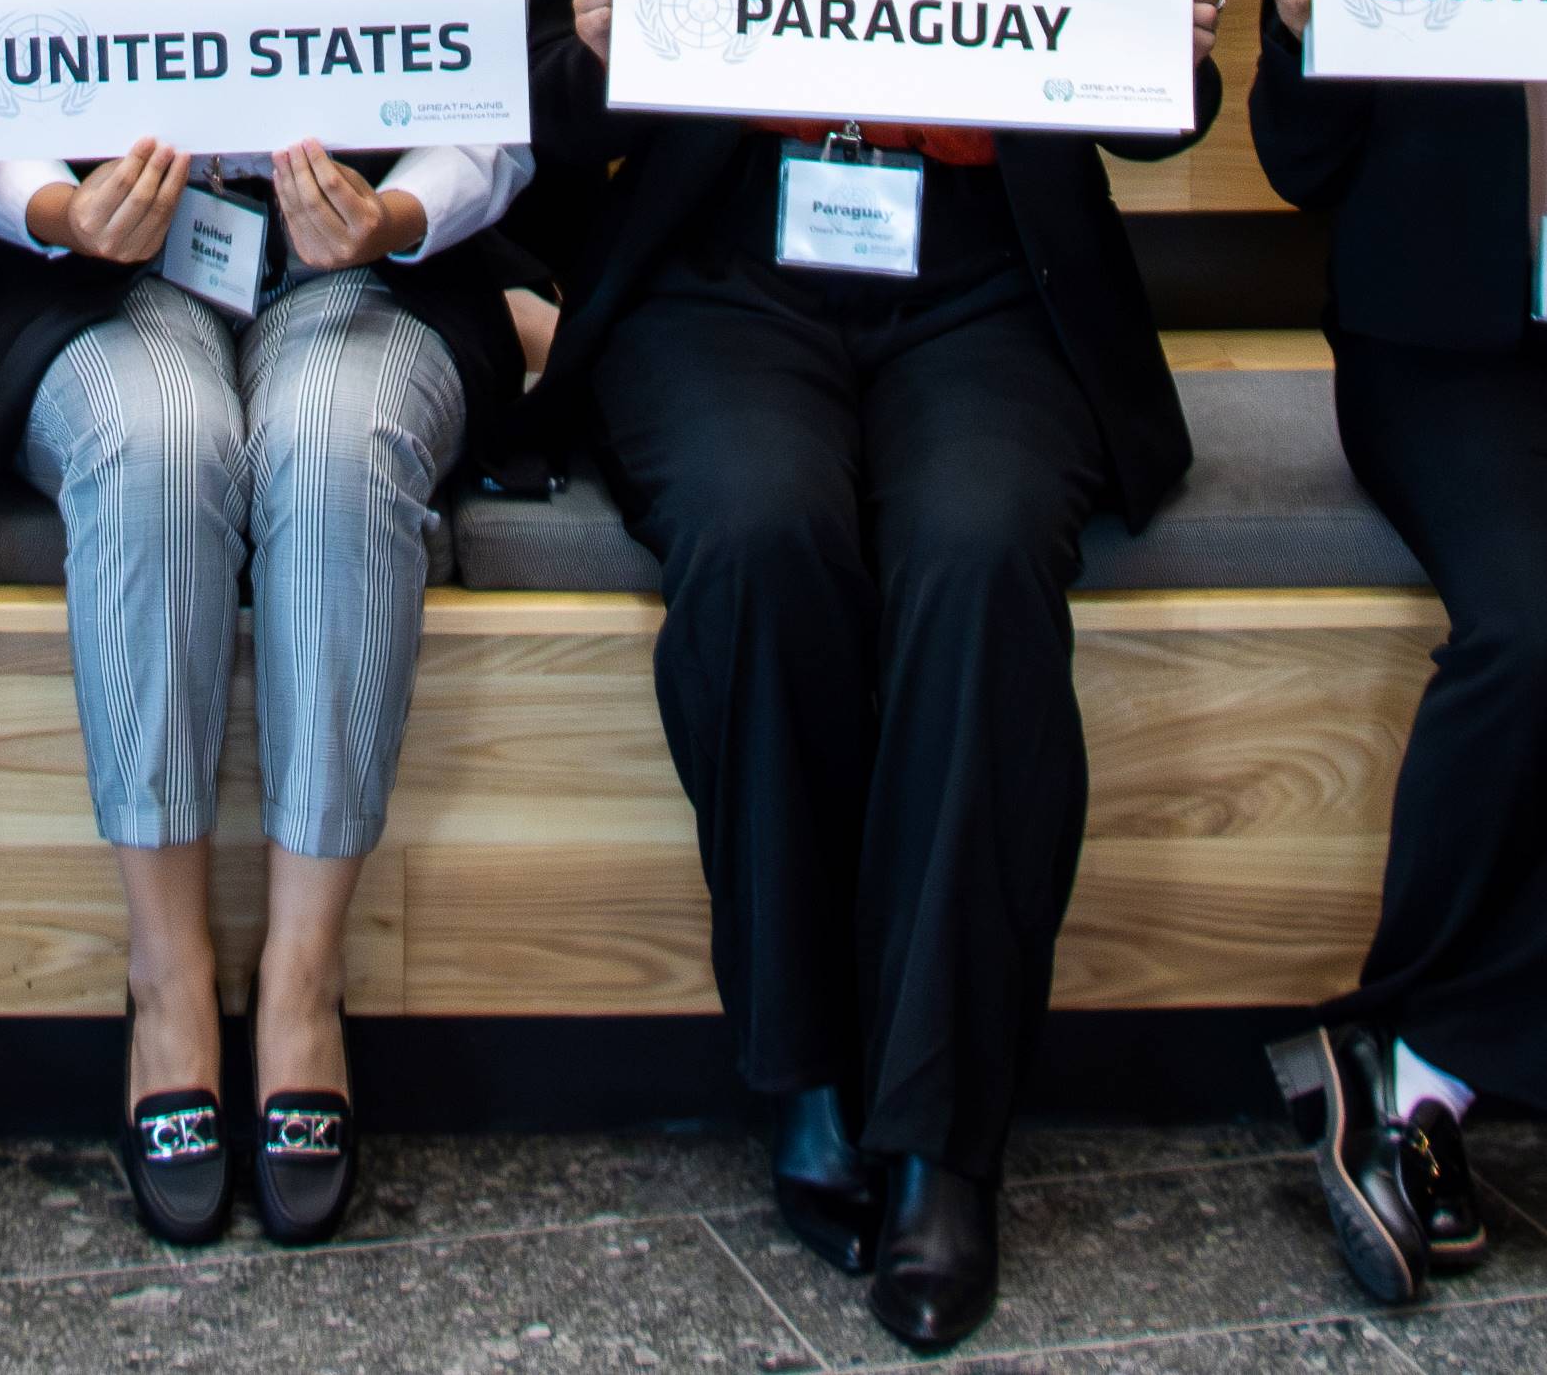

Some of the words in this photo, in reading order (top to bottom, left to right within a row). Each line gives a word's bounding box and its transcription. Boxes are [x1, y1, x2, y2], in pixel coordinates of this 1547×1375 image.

[4, 31, 228, 86] UNITED
[249, 22, 472, 78] STATES
[417, 102, 459, 112] GREAT
[460, 101, 503, 111] PLAINS
[812, 200, 892, 224] Paraguay
[193, 219, 233, 245] United
[190, 239, 230, 264] States
